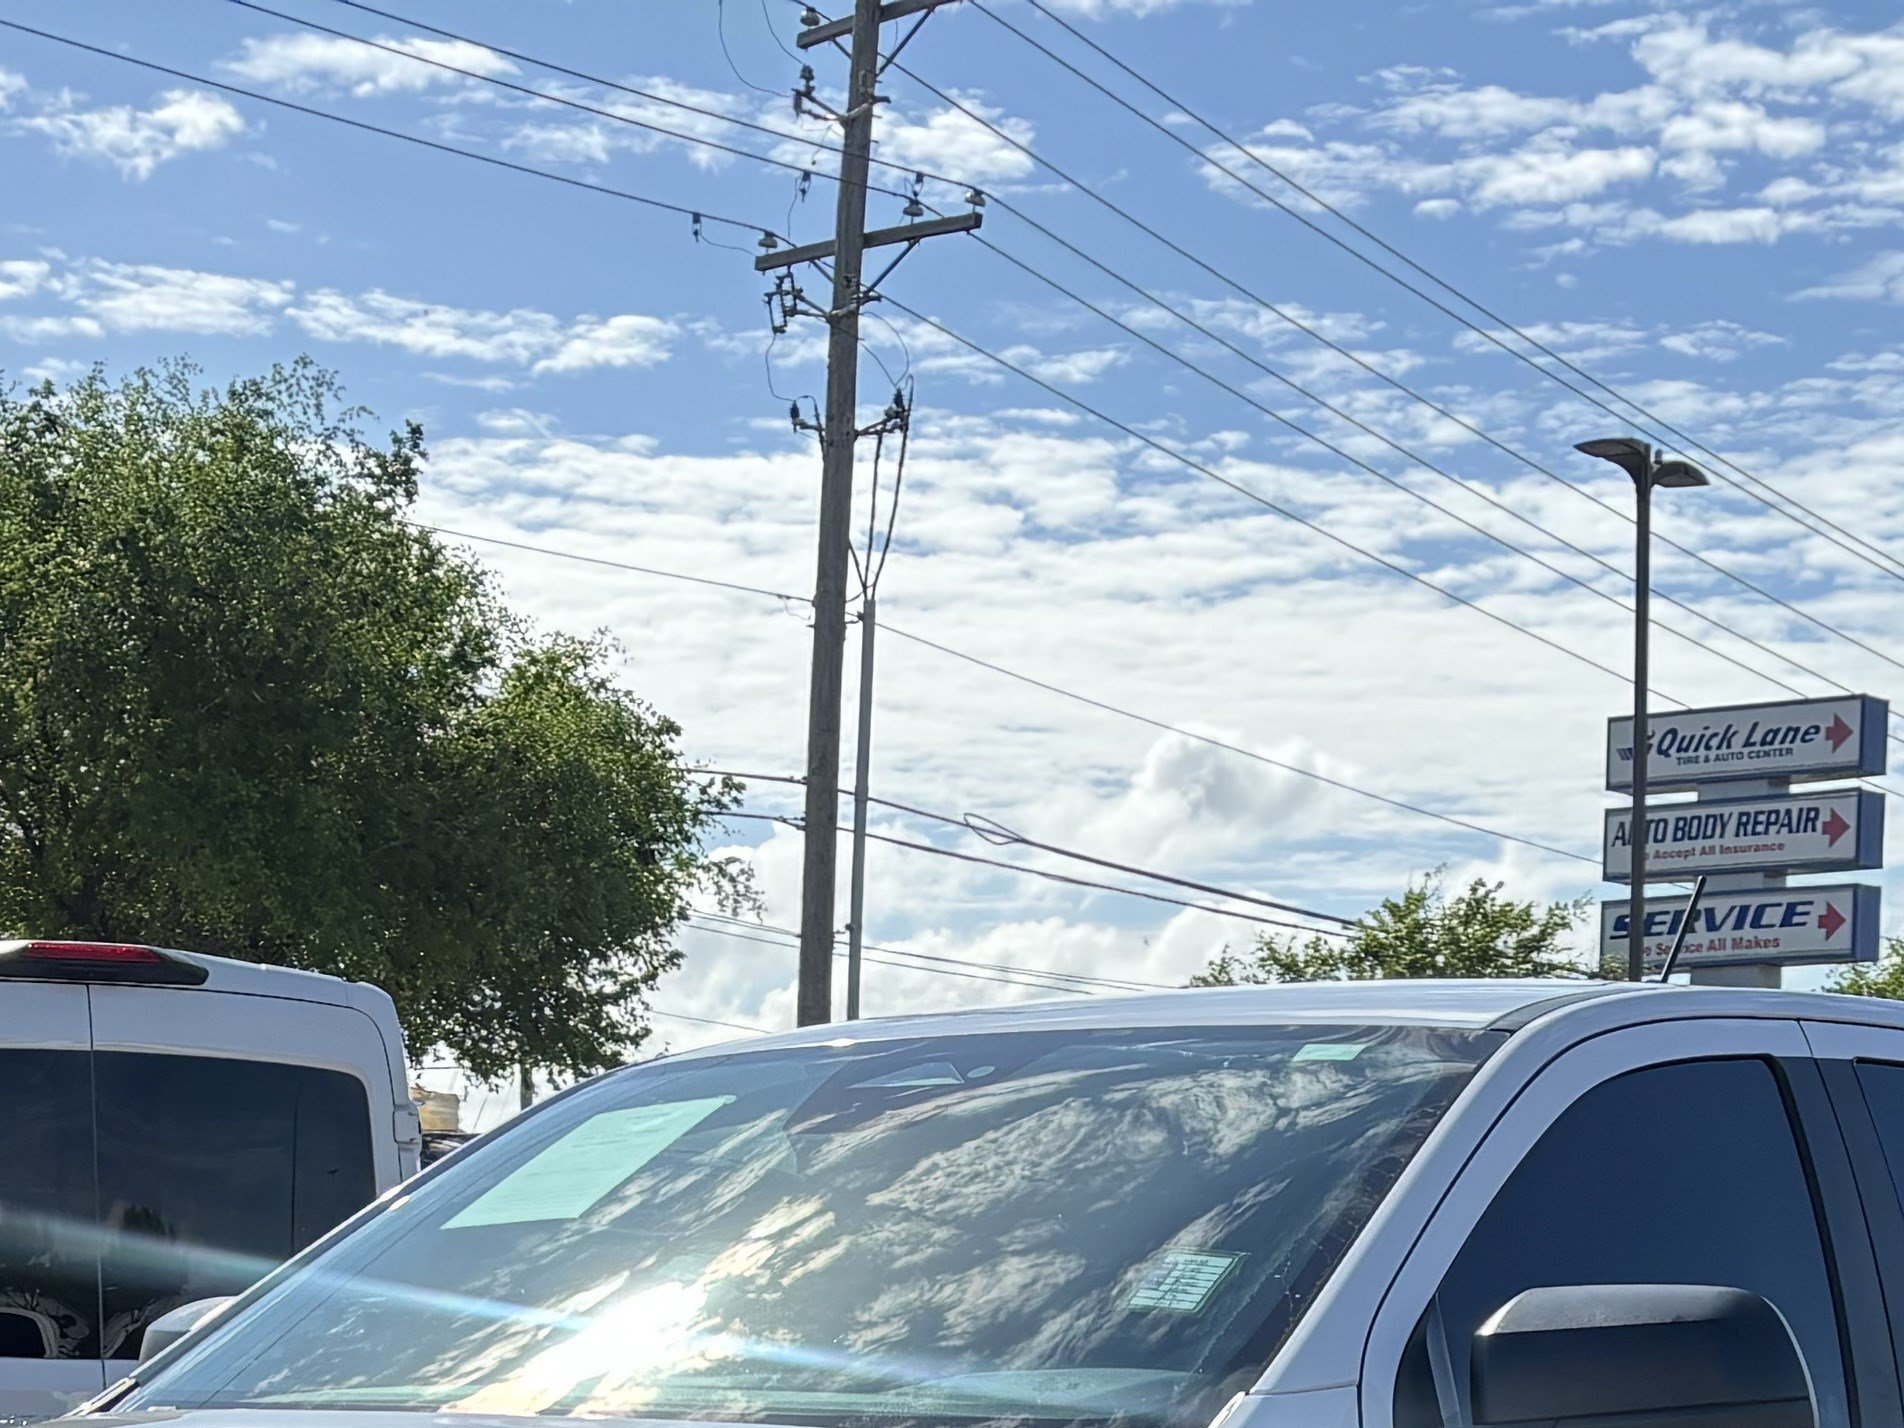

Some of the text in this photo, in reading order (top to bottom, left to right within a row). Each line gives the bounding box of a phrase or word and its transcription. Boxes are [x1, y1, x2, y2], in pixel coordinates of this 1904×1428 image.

[1656, 721, 1821, 758] Quick Lane
[1676, 756, 1700, 766] TIRE
[1714, 752, 1744, 762] AUTO
[1747, 746, 1794, 760] CENTER
[1611, 807, 1820, 847] ATO BODY REPAIR
[1653, 847, 1696, 861] Accept
[1700, 845, 1716, 856] All
[1720, 842, 1786, 855] Insurance
[1707, 938, 1726, 951] All
[1732, 937, 1780, 950] Makes
